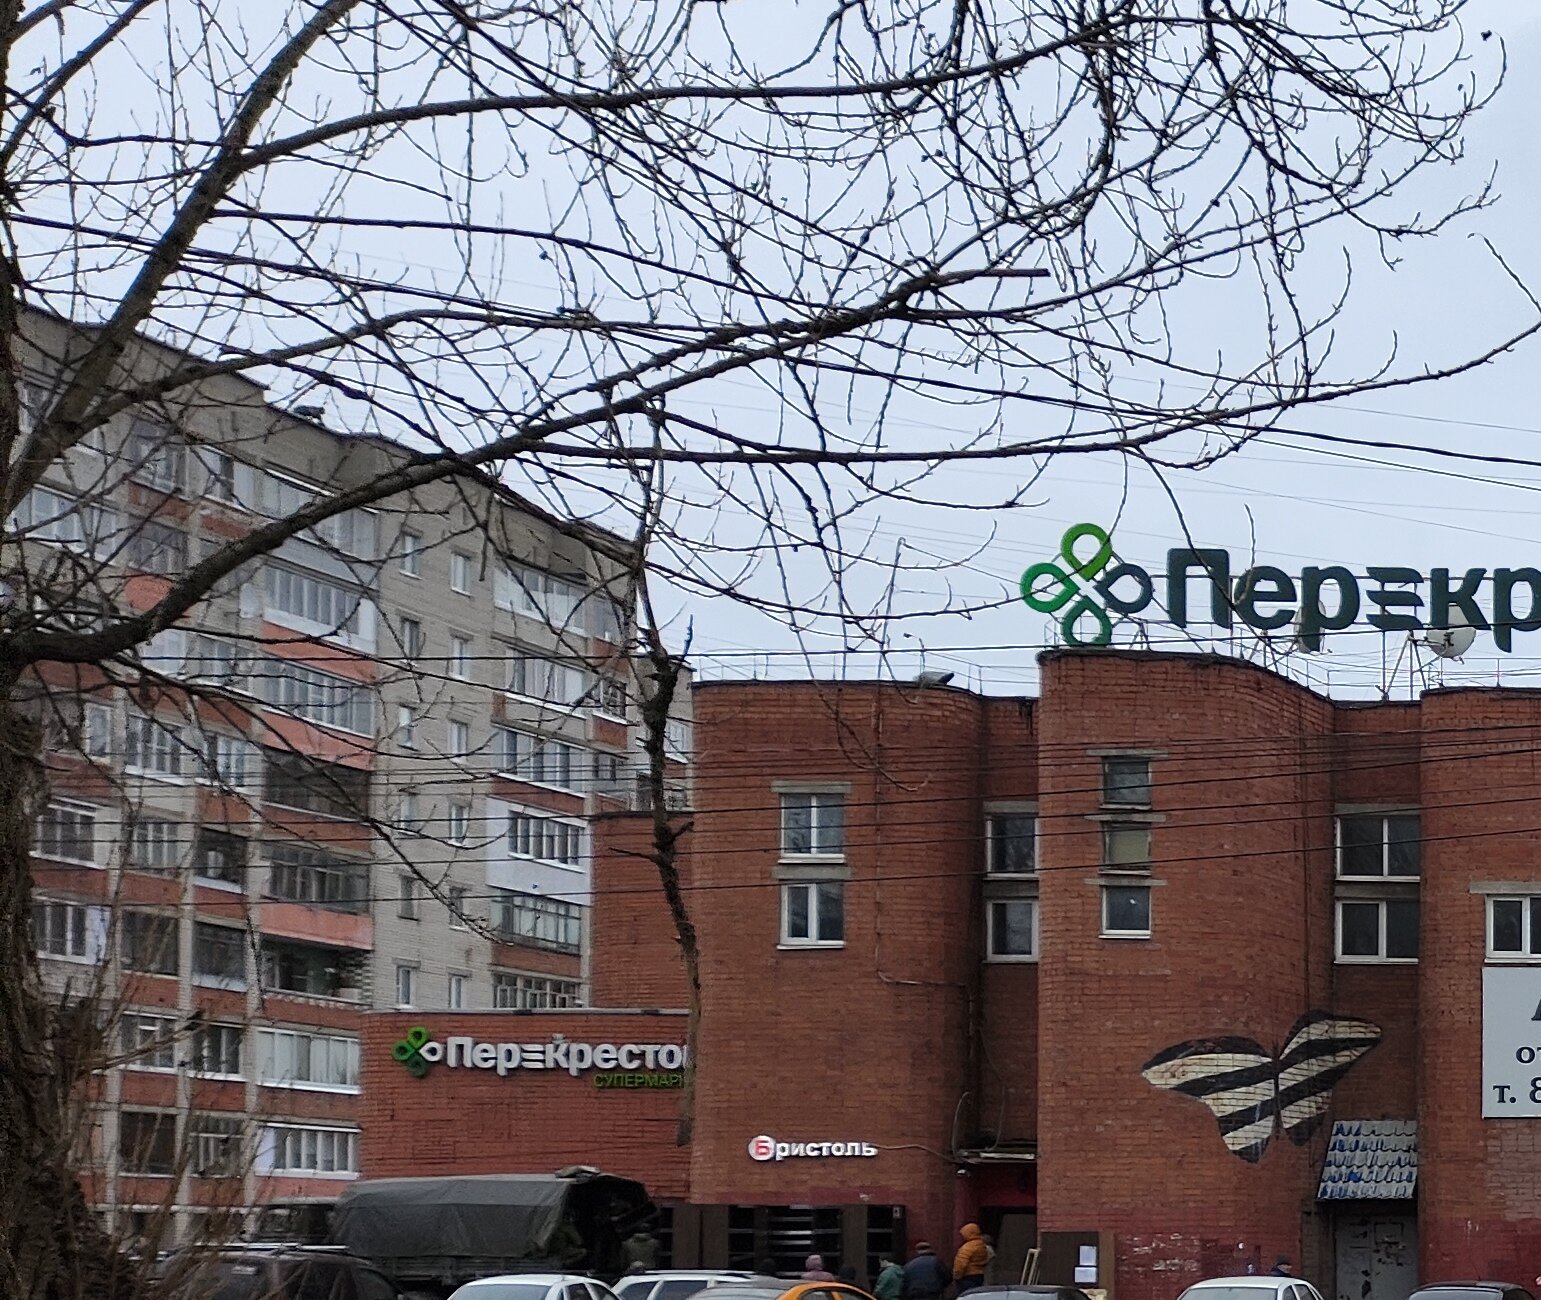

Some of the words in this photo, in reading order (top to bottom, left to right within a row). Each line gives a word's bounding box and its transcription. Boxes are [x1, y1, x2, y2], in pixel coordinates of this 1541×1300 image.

[446, 1034, 689, 1076] Перекресто
[1493, 1084, 1517, 1104] т.
[749, 1135, 878, 1161] Бристоль
